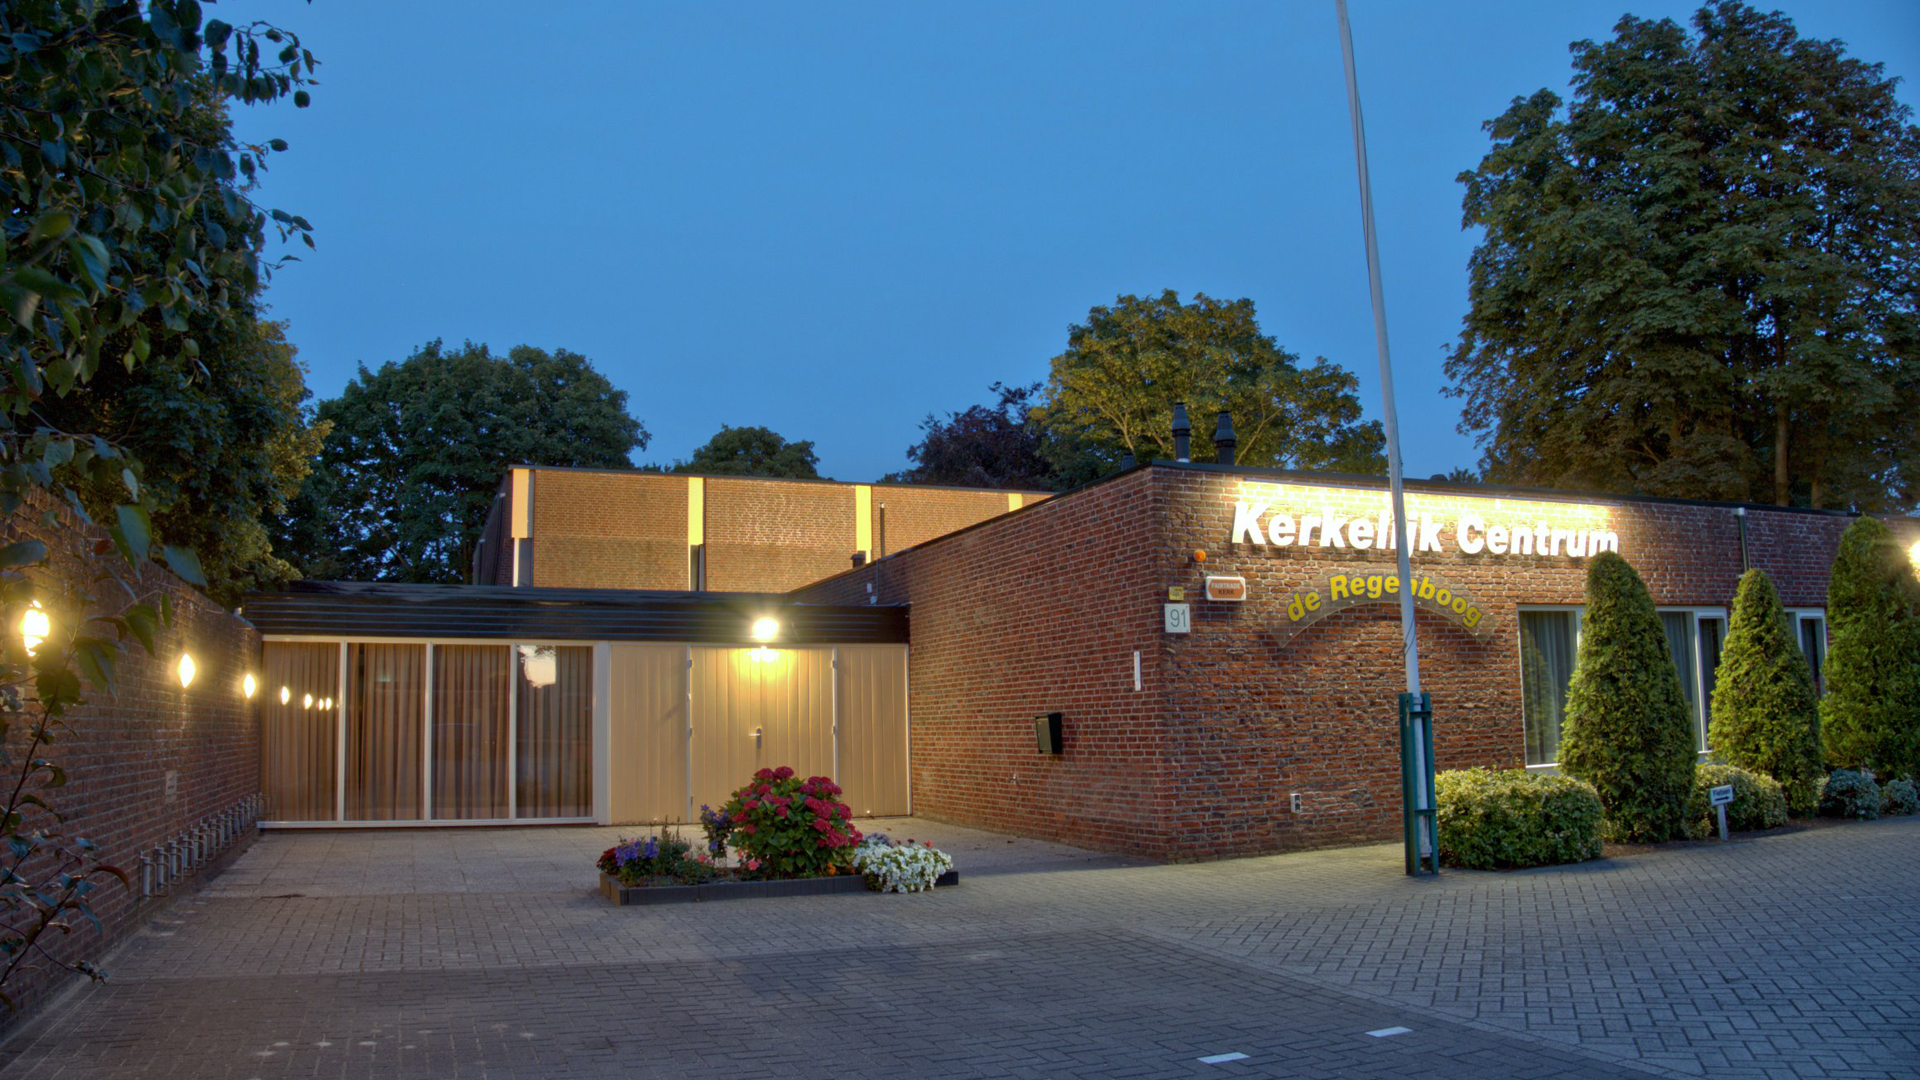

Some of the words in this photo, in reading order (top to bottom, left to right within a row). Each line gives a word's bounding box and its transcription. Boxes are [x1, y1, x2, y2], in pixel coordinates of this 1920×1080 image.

[1457, 512, 1619, 558] Centrum
[1170, 608, 1186, 628] 91
[1287, 592, 1321, 622] de
